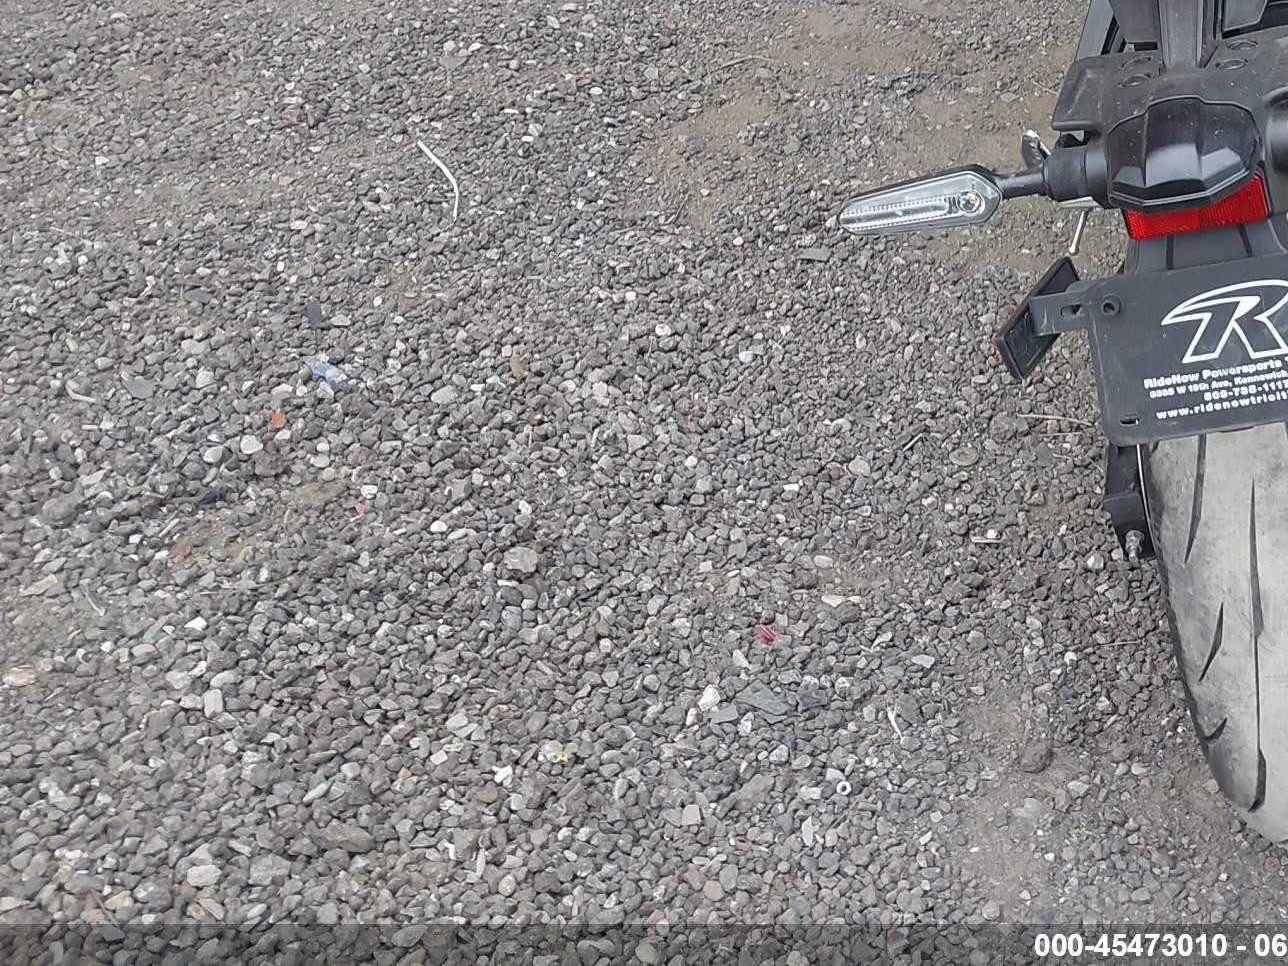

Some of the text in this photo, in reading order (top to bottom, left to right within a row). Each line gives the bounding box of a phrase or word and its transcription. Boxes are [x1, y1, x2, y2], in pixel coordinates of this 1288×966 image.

[1143, 372, 1200, 390] RideNow
[1202, 359, 1283, 380] Powersports
[1176, 385, 1187, 395] W
